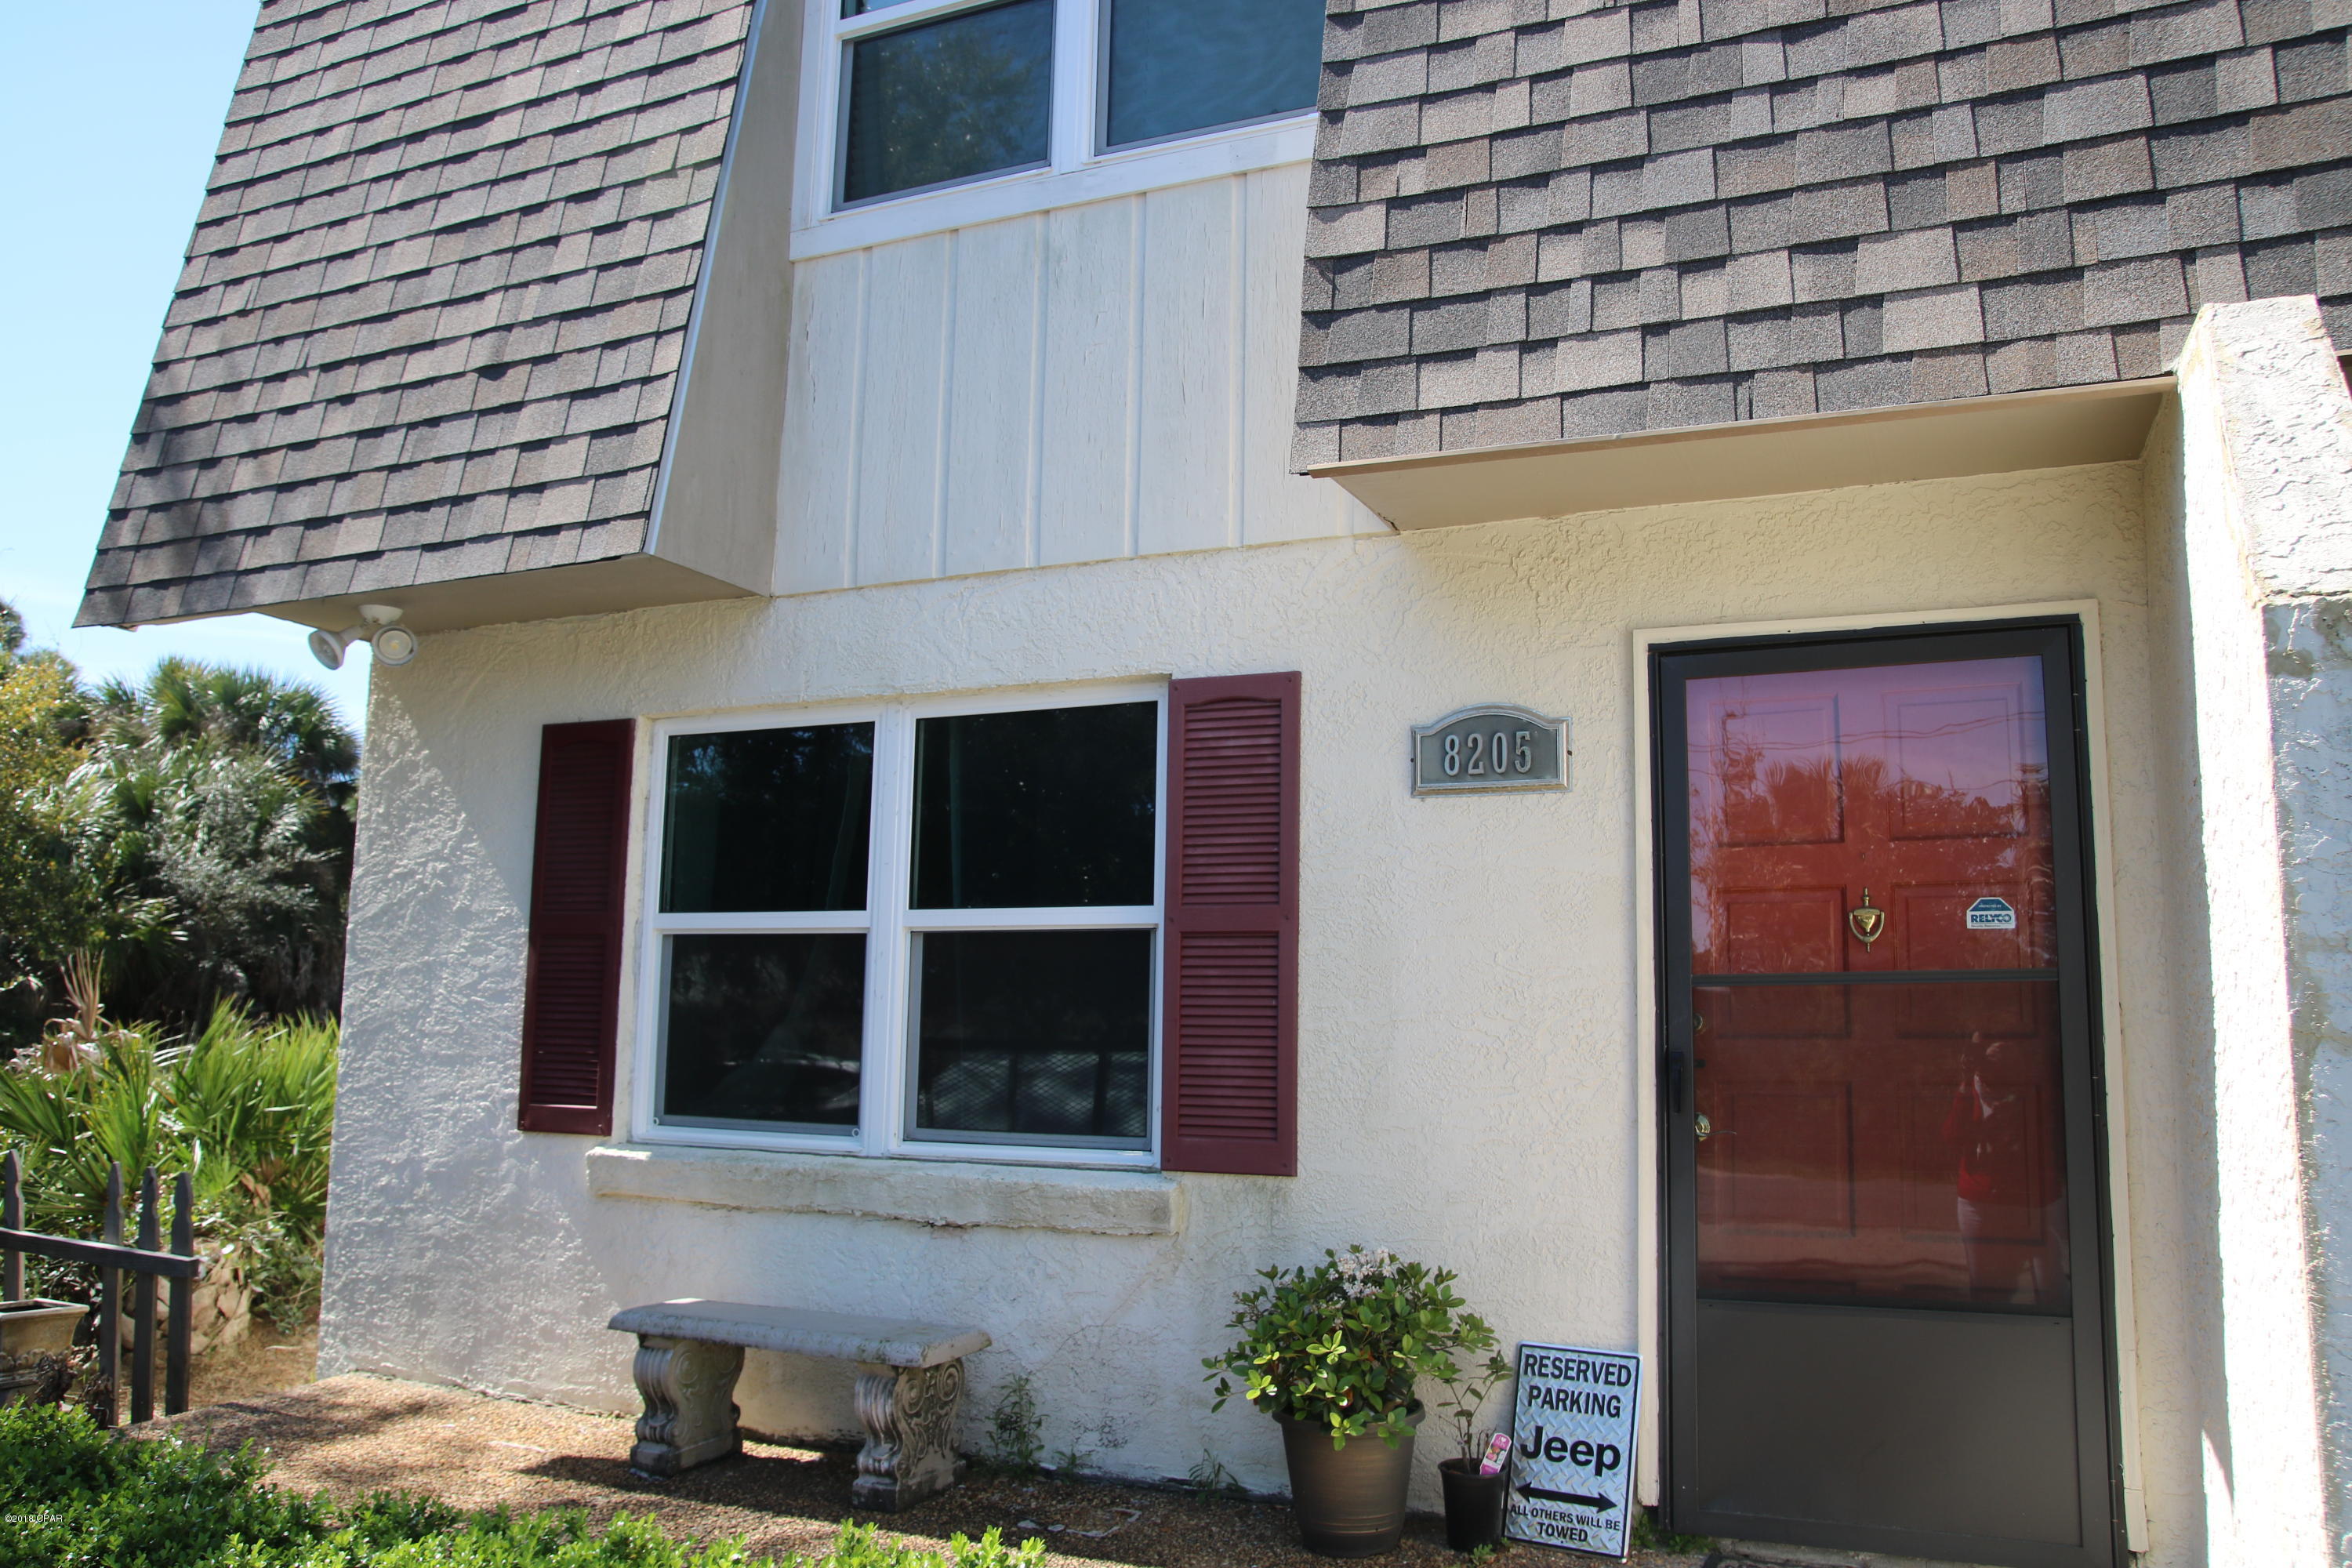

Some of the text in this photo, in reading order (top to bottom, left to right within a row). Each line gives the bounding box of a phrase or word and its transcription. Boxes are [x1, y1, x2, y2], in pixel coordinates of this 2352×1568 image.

[1443, 731, 1532, 776] 8205
[1523, 1353, 1632, 1387] RESERVED
[1528, 1385, 1621, 1418] PARKING
[1519, 1425, 1621, 1477] Jeep
[1510, 1504, 1621, 1531] ALL OTHERS WILL BE
[1537, 1522, 1588, 1543] TOWED
